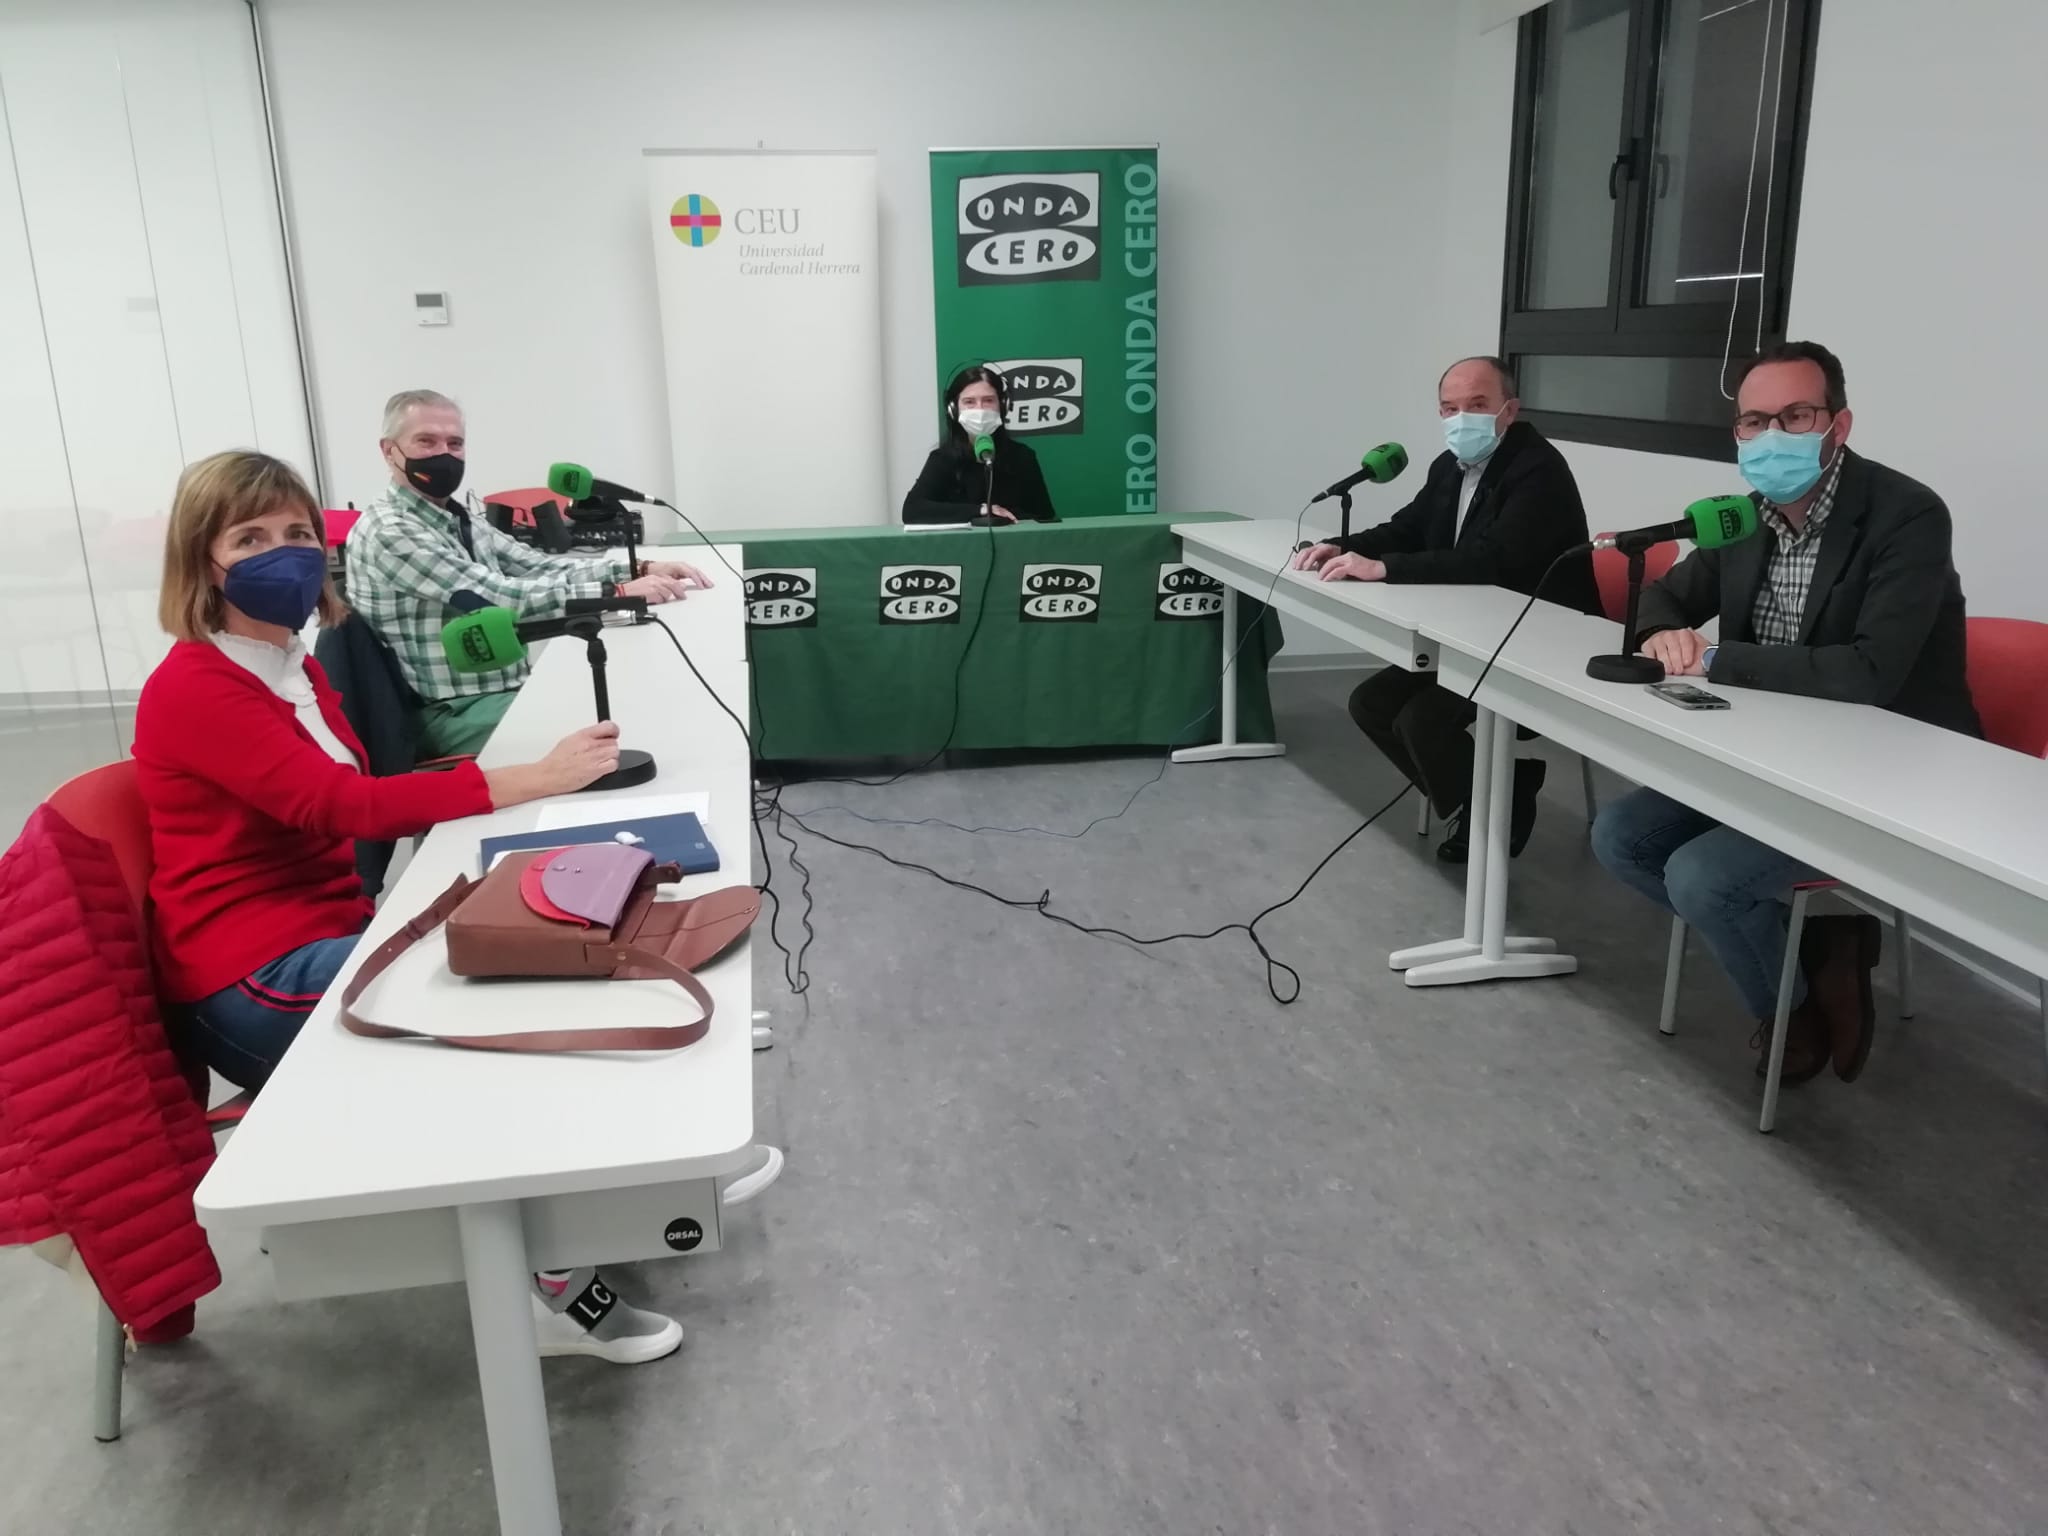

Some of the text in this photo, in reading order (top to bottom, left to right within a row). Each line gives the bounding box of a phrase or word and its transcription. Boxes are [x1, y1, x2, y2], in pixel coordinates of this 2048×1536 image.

[976, 196, 1078, 221] ONDA
[734, 208, 800, 234] CEU
[1124, 163, 1157, 278] CERO
[739, 243, 824, 257] Universidad
[983, 238, 1079, 265] CERO
[739, 261, 861, 275] Cardenal Herrera
[1124, 288, 1157, 414] ONDA
[744, 580, 805, 594] ONDA
[890, 576, 950, 590] ONDA
[1032, 575, 1089, 588] ONDA
[894, 600, 949, 615] CERO
[1034, 599, 1088, 613] CERO
[1169, 597, 1222, 611] CERO
[749, 604, 805, 619] CERO
[666, 1229, 701, 1241] ORSAL
